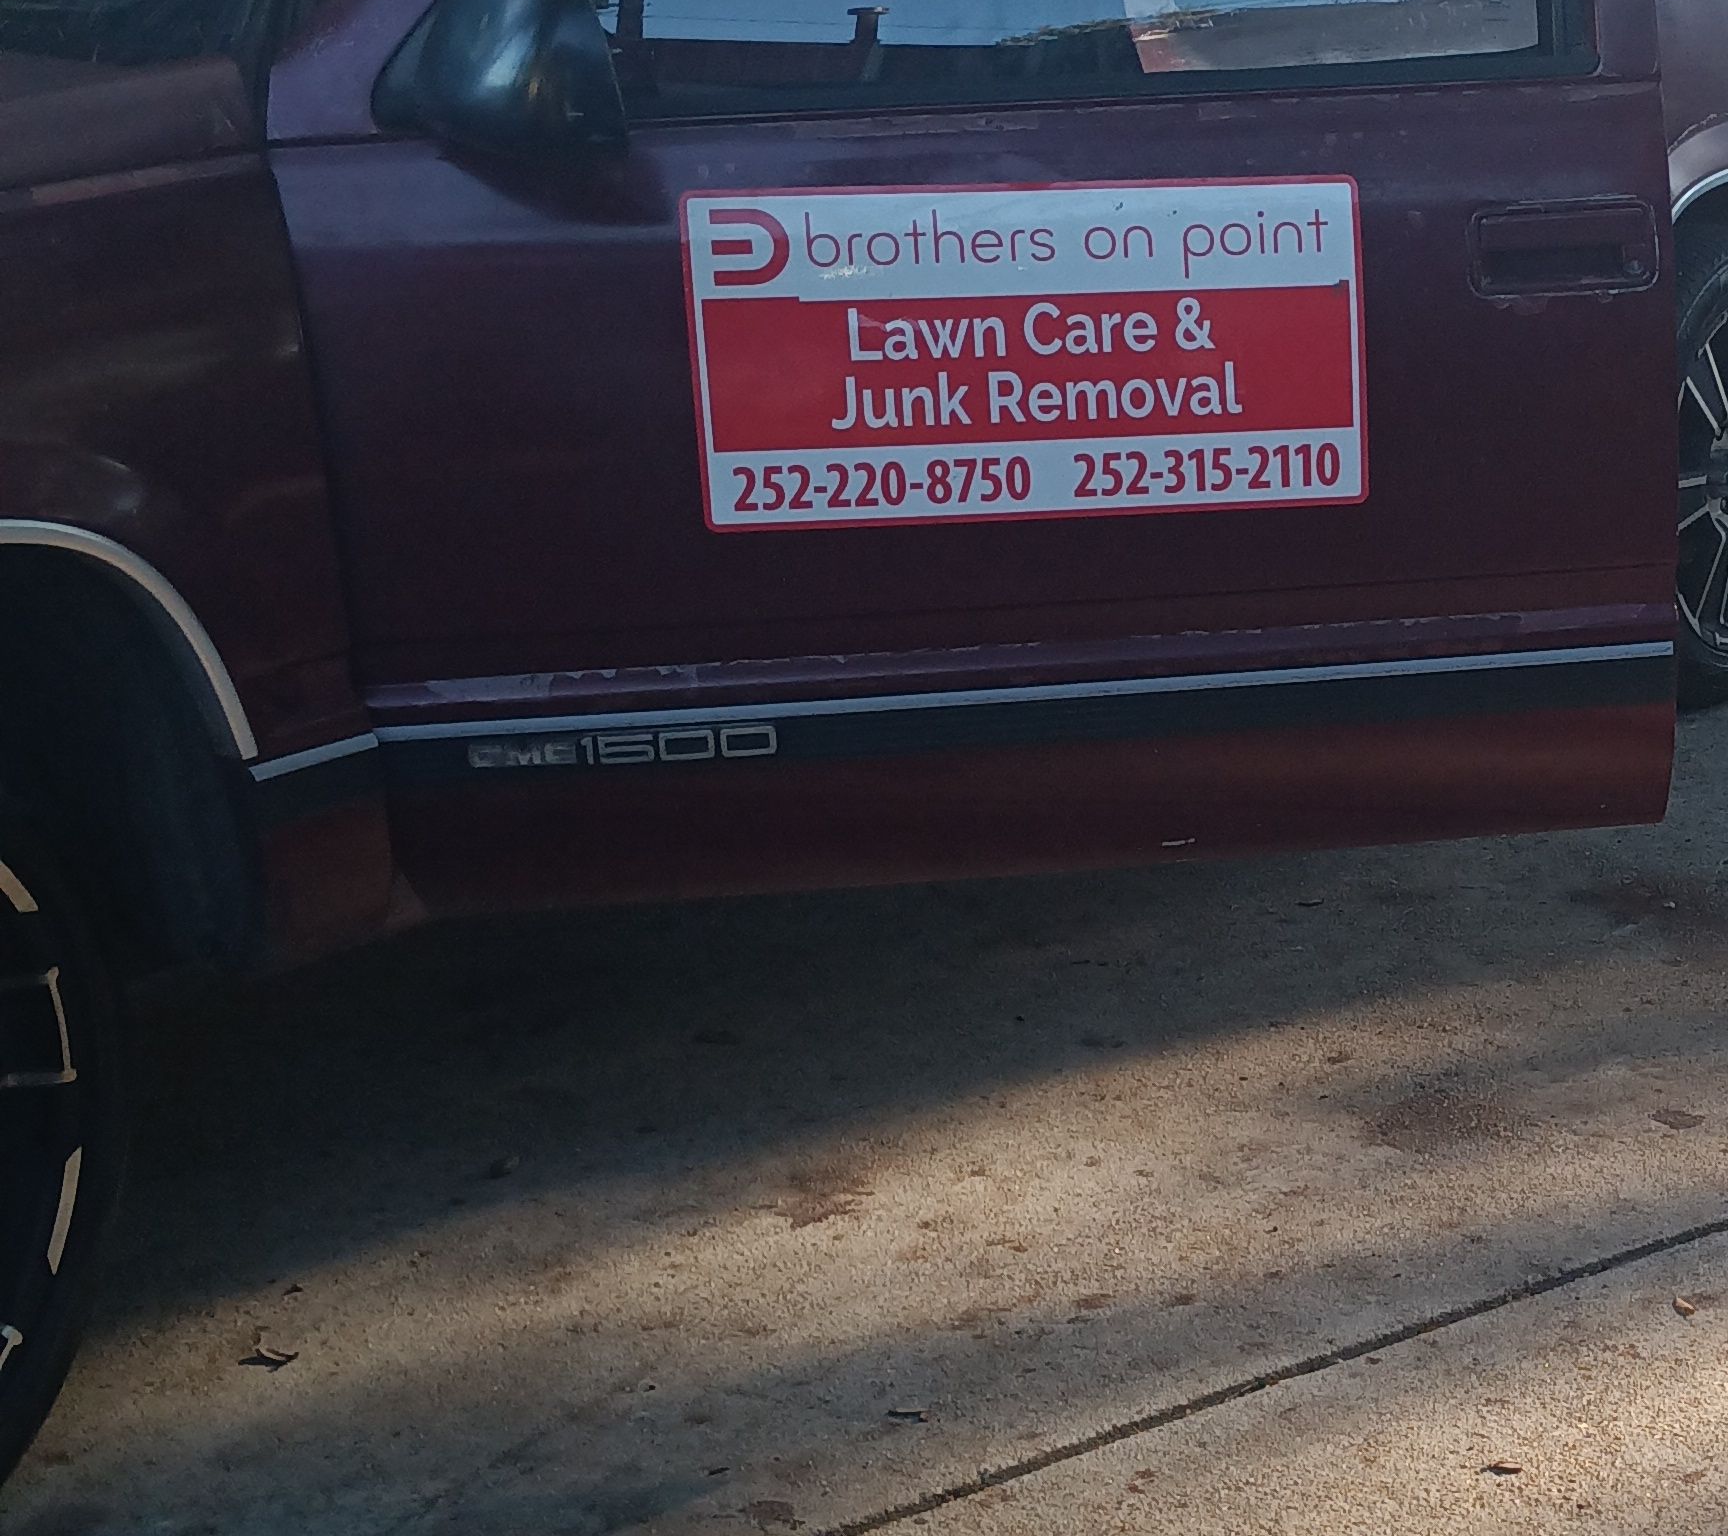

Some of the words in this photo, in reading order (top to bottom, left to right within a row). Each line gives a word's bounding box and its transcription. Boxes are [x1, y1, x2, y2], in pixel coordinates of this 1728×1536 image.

[803, 210, 1057, 268] brothers
[1084, 225, 1154, 260] on
[1182, 208, 1329, 279] point
[847, 307, 1007, 362] Lawn
[1023, 302, 1158, 355] Care
[1174, 296, 1215, 352] &
[831, 372, 972, 430] Junk
[987, 361, 1243, 424] Removal
[732, 455, 1031, 512] 252-220-8750
[1073, 442, 1341, 499] 252-315-2110
[580, 726, 777, 764] 1500
